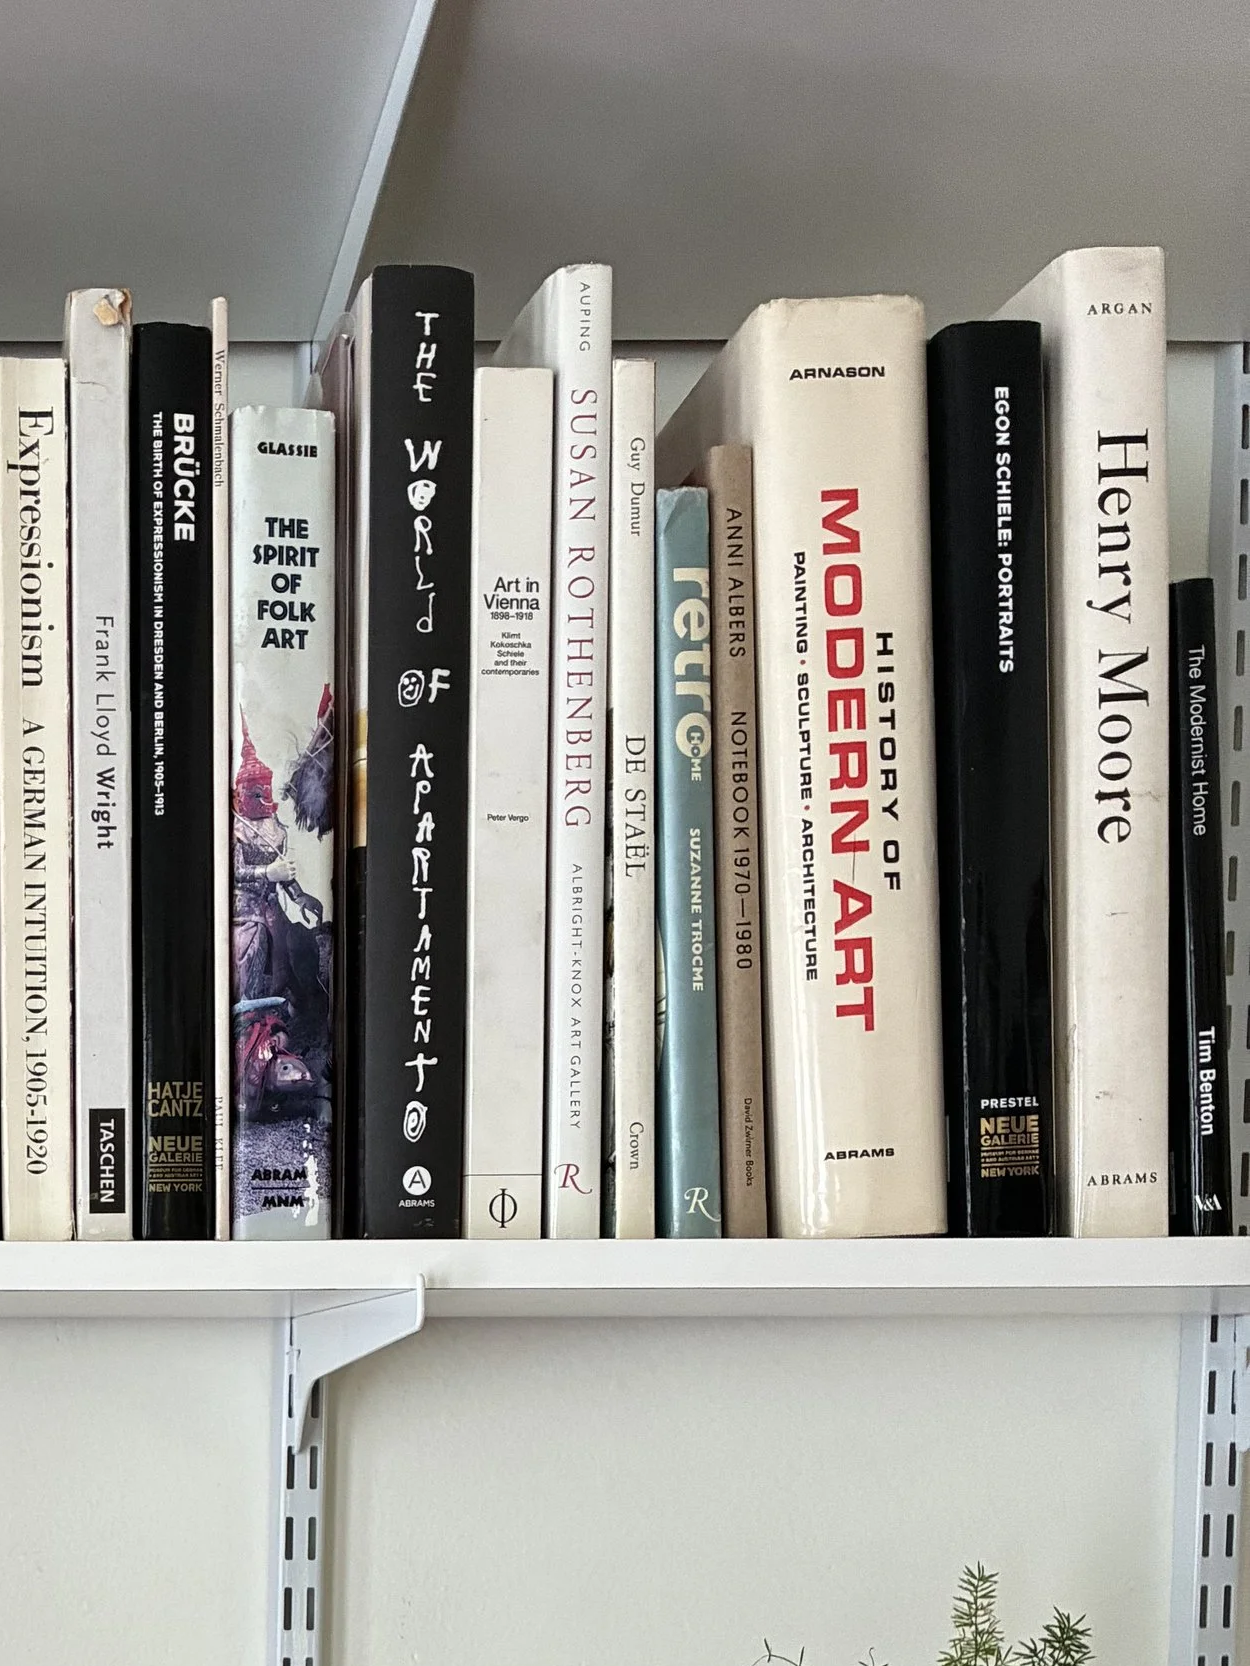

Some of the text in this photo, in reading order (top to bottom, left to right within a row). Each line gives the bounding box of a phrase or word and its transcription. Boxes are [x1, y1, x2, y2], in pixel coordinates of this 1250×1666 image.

[414, 312, 440, 402] THE
[578, 282, 592, 352] AUPING
[1087, 302, 1152, 316] ARGAN
[214, 350, 226, 488] Werner Schmalenbach
[789, 366, 886, 380] ARNASON
[172, 412, 200, 542] BRÜCKE
[257, 442, 318, 458] GLASSIE
[628, 438, 646, 536] Guy Dumur
[6, 407, 54, 688] Expressionism
[253, 544, 320, 567] SPIRIT
[265, 517, 308, 539] THE
[726, 508, 746, 658] ANNI ALBERS
[994, 386, 1014, 672] EGON SCHIELE: PORTRAITS
[258, 600, 316, 622] FOLK
[271, 573, 302, 594] OF
[484, 594, 540, 610] Vienna
[494, 576, 540, 592] Art in
[564, 389, 598, 828] SUSAN ROTHENBERG
[1086, 428, 1150, 844] Henry Moore
[261, 628, 308, 650] ART
[490, 641, 532, 649] Kokoschka
[672, 566, 712, 758] retro
[92, 616, 117, 849] Frank Lloyd Wright
[730, 712, 750, 838] NOTEBOOK
[793, 552, 819, 981] PAINTING SCULPTURE ARCHITECTURE
[821, 488, 874, 1032] MODERN ART
[876, 632, 900, 891] HISTORY OF
[1188, 645, 1209, 836] The Modernist Home
[487, 813, 530, 824] Peter Vergo
[624, 736, 649, 878] DE STAËL
[21, 718, 49, 1175] A GERMAN INTUITION, 1905-1920
[690, 828, 705, 991] SUZANNE TROCME
[980, 1096, 1040, 1109] PRESTEL
[1198, 1026, 1217, 1136] Tim Benton
[1087, 1172, 1158, 1186] ABRAMS
